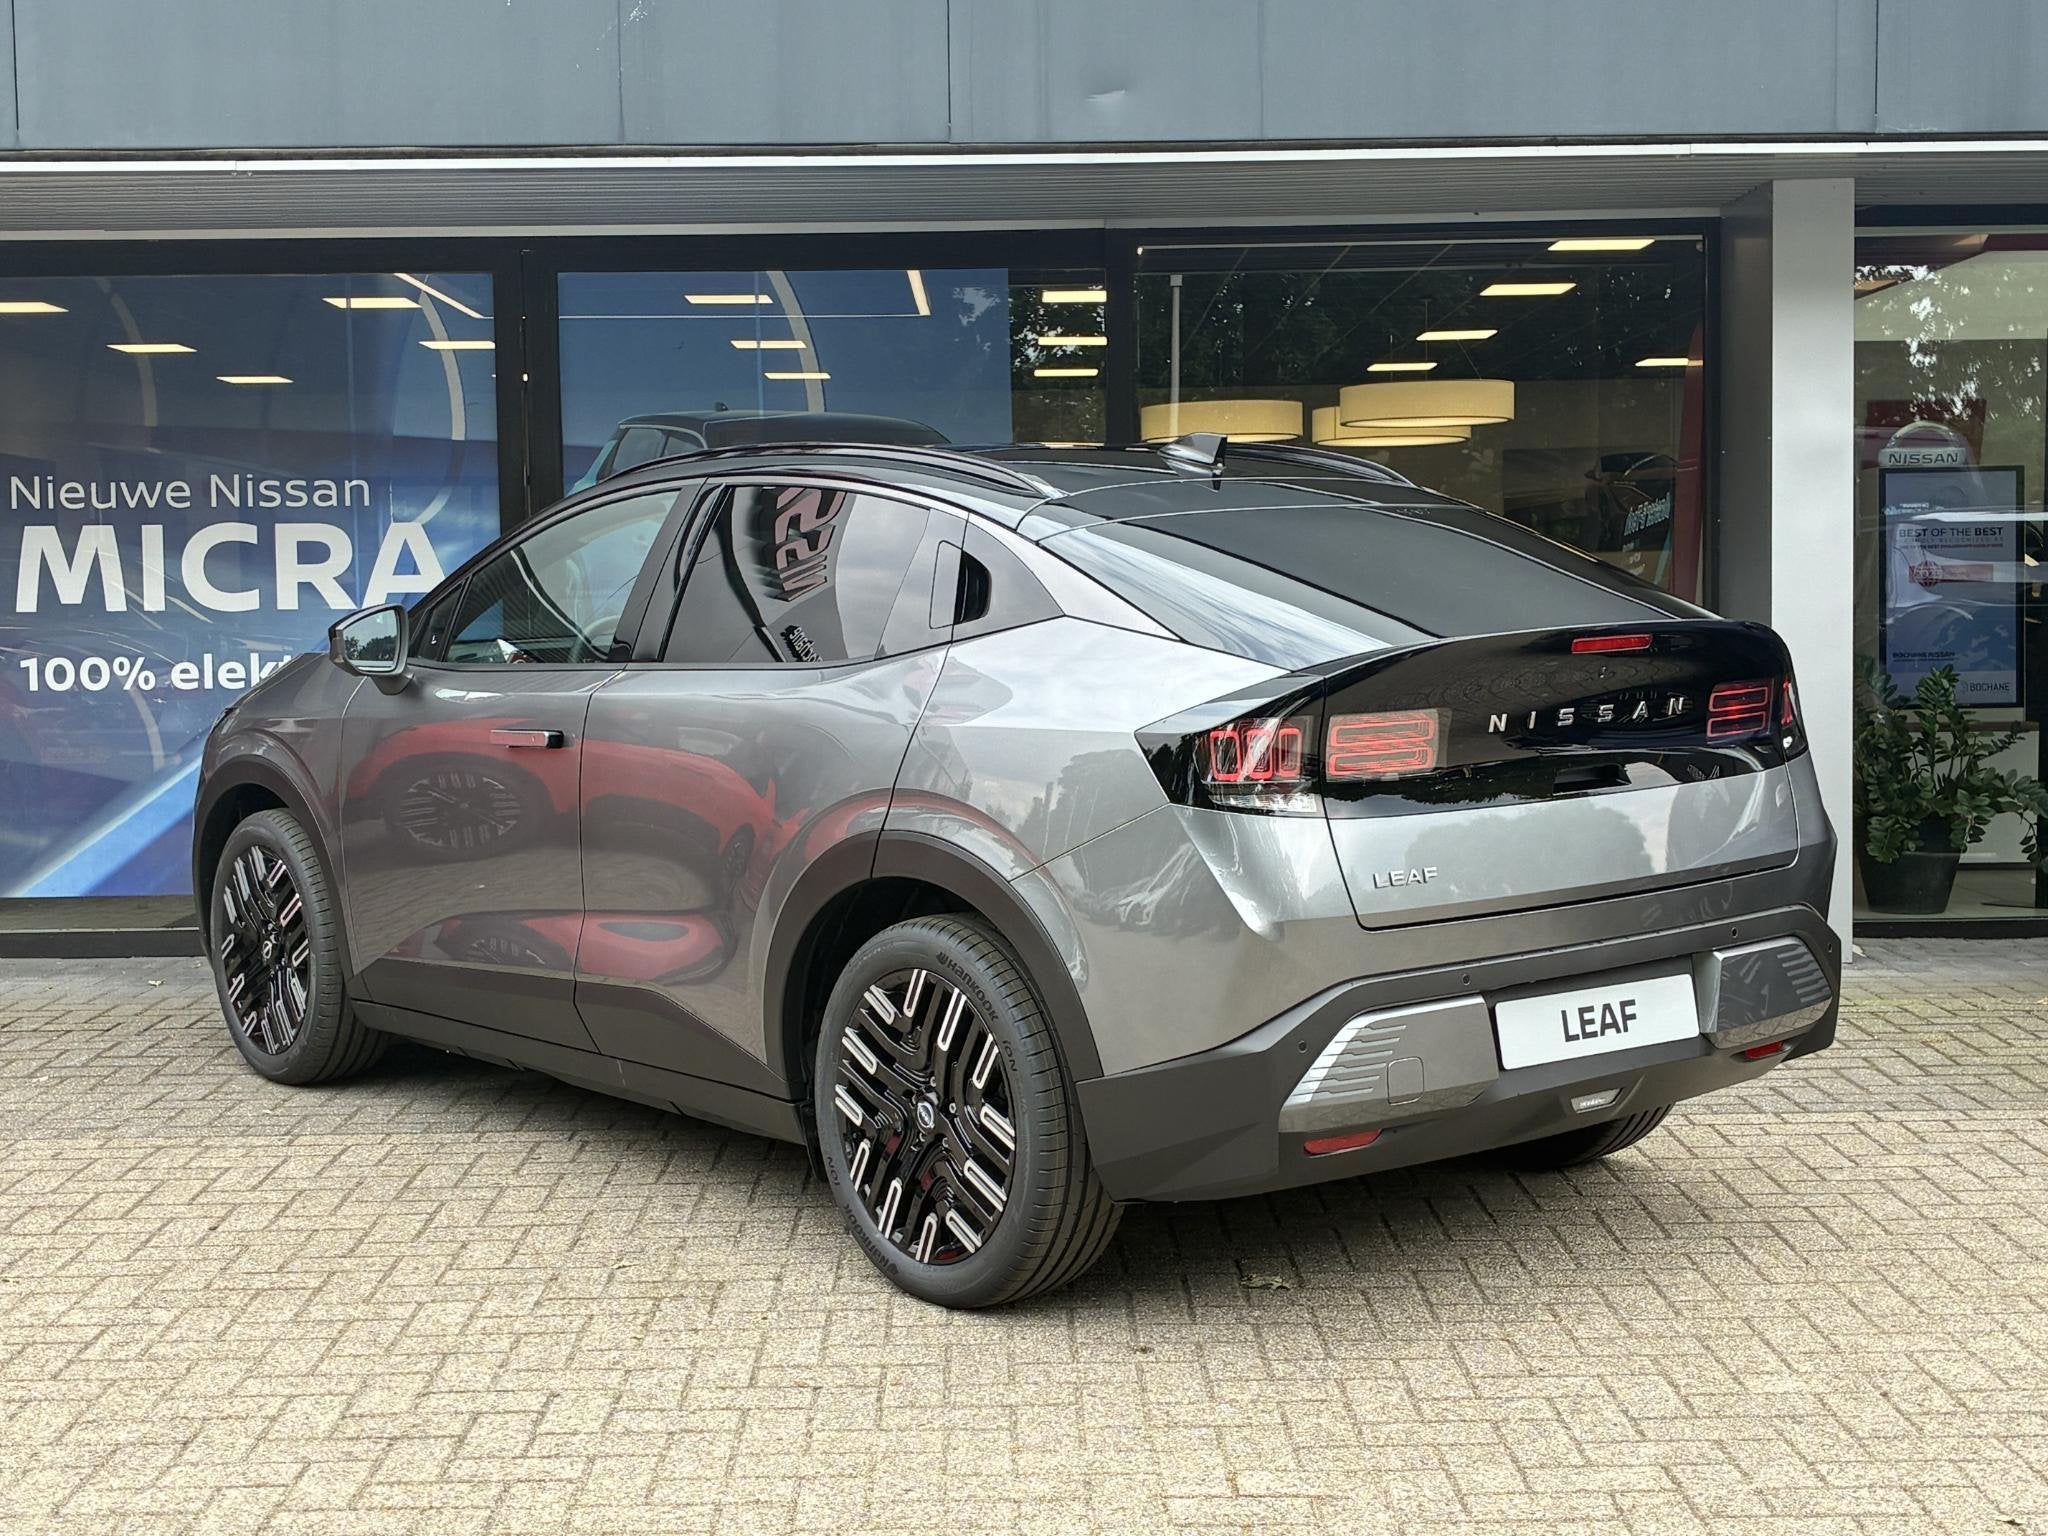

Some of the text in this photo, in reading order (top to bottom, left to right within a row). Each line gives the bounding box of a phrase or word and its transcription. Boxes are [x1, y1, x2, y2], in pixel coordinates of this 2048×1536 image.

[1888, 452, 1959, 465] NISSAN
[10, 473, 370, 510] Nieuwe Nissan
[1899, 526, 2004, 538] BEST OF THE BEST
[15, 521, 448, 613] MICRA
[19, 656, 156, 692] 100%
[1969, 682, 2010, 692] BOCHANE
[1487, 695, 1686, 734] NISSAN
[1372, 865, 1440, 890] LEAF
[1560, 998, 1638, 1045] LEAF
